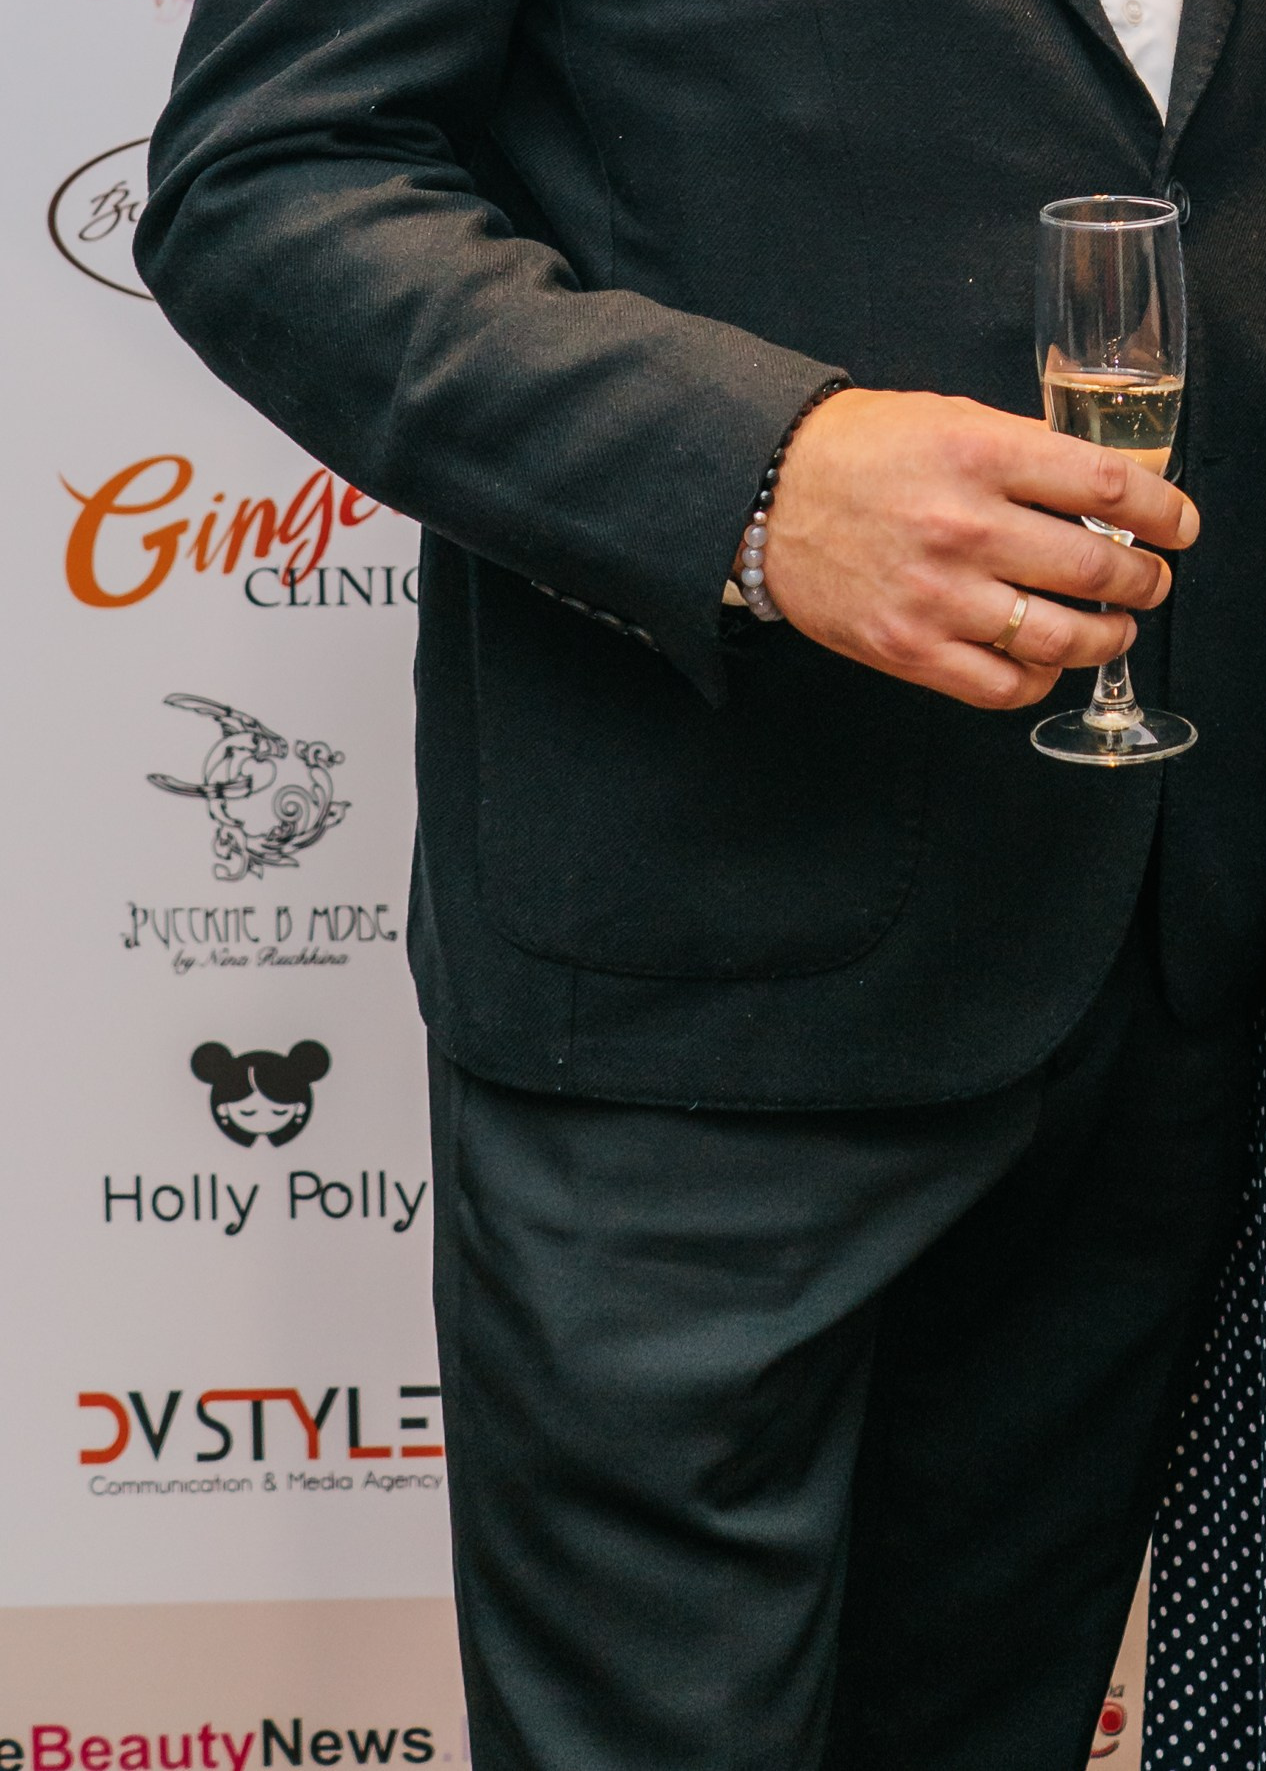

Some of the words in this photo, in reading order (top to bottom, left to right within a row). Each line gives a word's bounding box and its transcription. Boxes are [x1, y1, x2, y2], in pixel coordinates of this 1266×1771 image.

[58, 453, 402, 609] Ginge
[172, 948, 196, 975] by
[104, 1174, 259, 1235] Holly
[289, 1171, 427, 1233] Polly
[89, 1474, 252, 1497] Communication
[263, 1472, 278, 1492] &
[287, 1472, 354, 1492] Media
[364, 1470, 443, 1493] Agency
